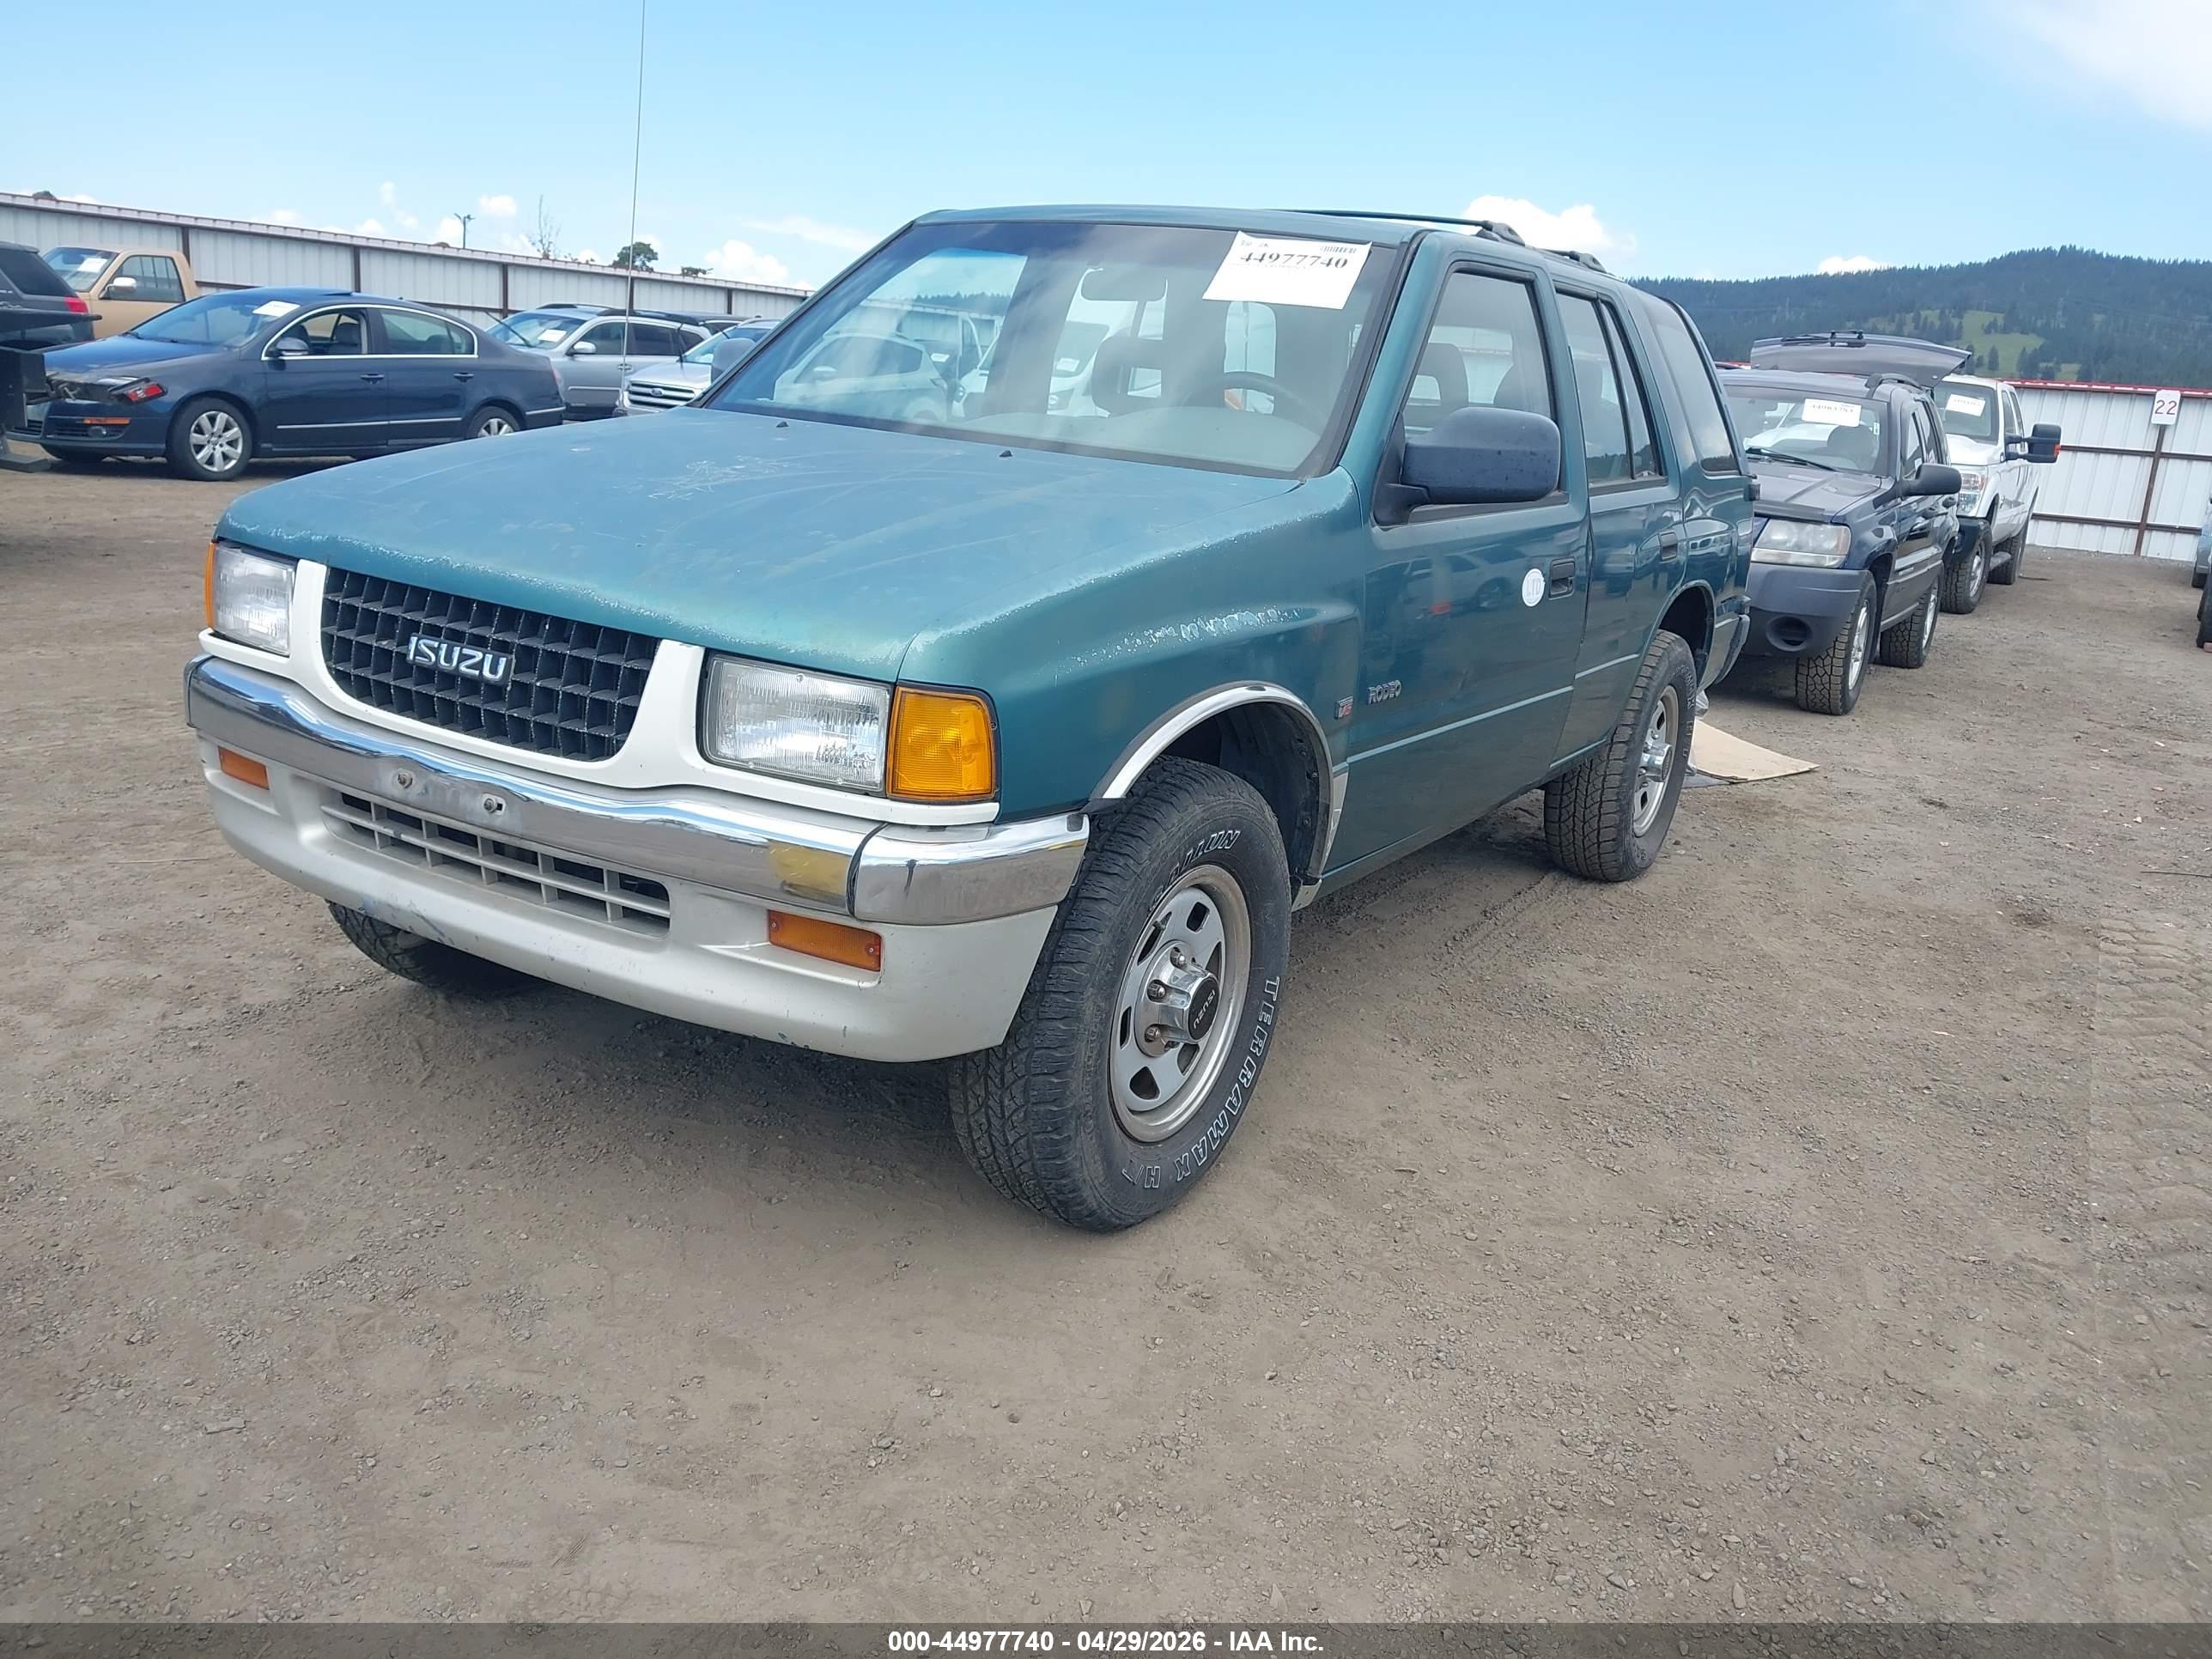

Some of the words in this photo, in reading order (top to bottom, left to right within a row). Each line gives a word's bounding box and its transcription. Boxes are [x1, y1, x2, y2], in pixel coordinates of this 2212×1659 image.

[1240, 252, 1349, 269] 44977740
[2154, 399, 2178, 416] 22
[408, 635, 507, 682] ISUZU
[1368, 679, 1402, 705] RODEO
[1193, 988, 1216, 1030] ISUZU
[1174, 975, 1280, 1182] TERRAMAX
[1121, 1158, 1161, 1188] H/T
